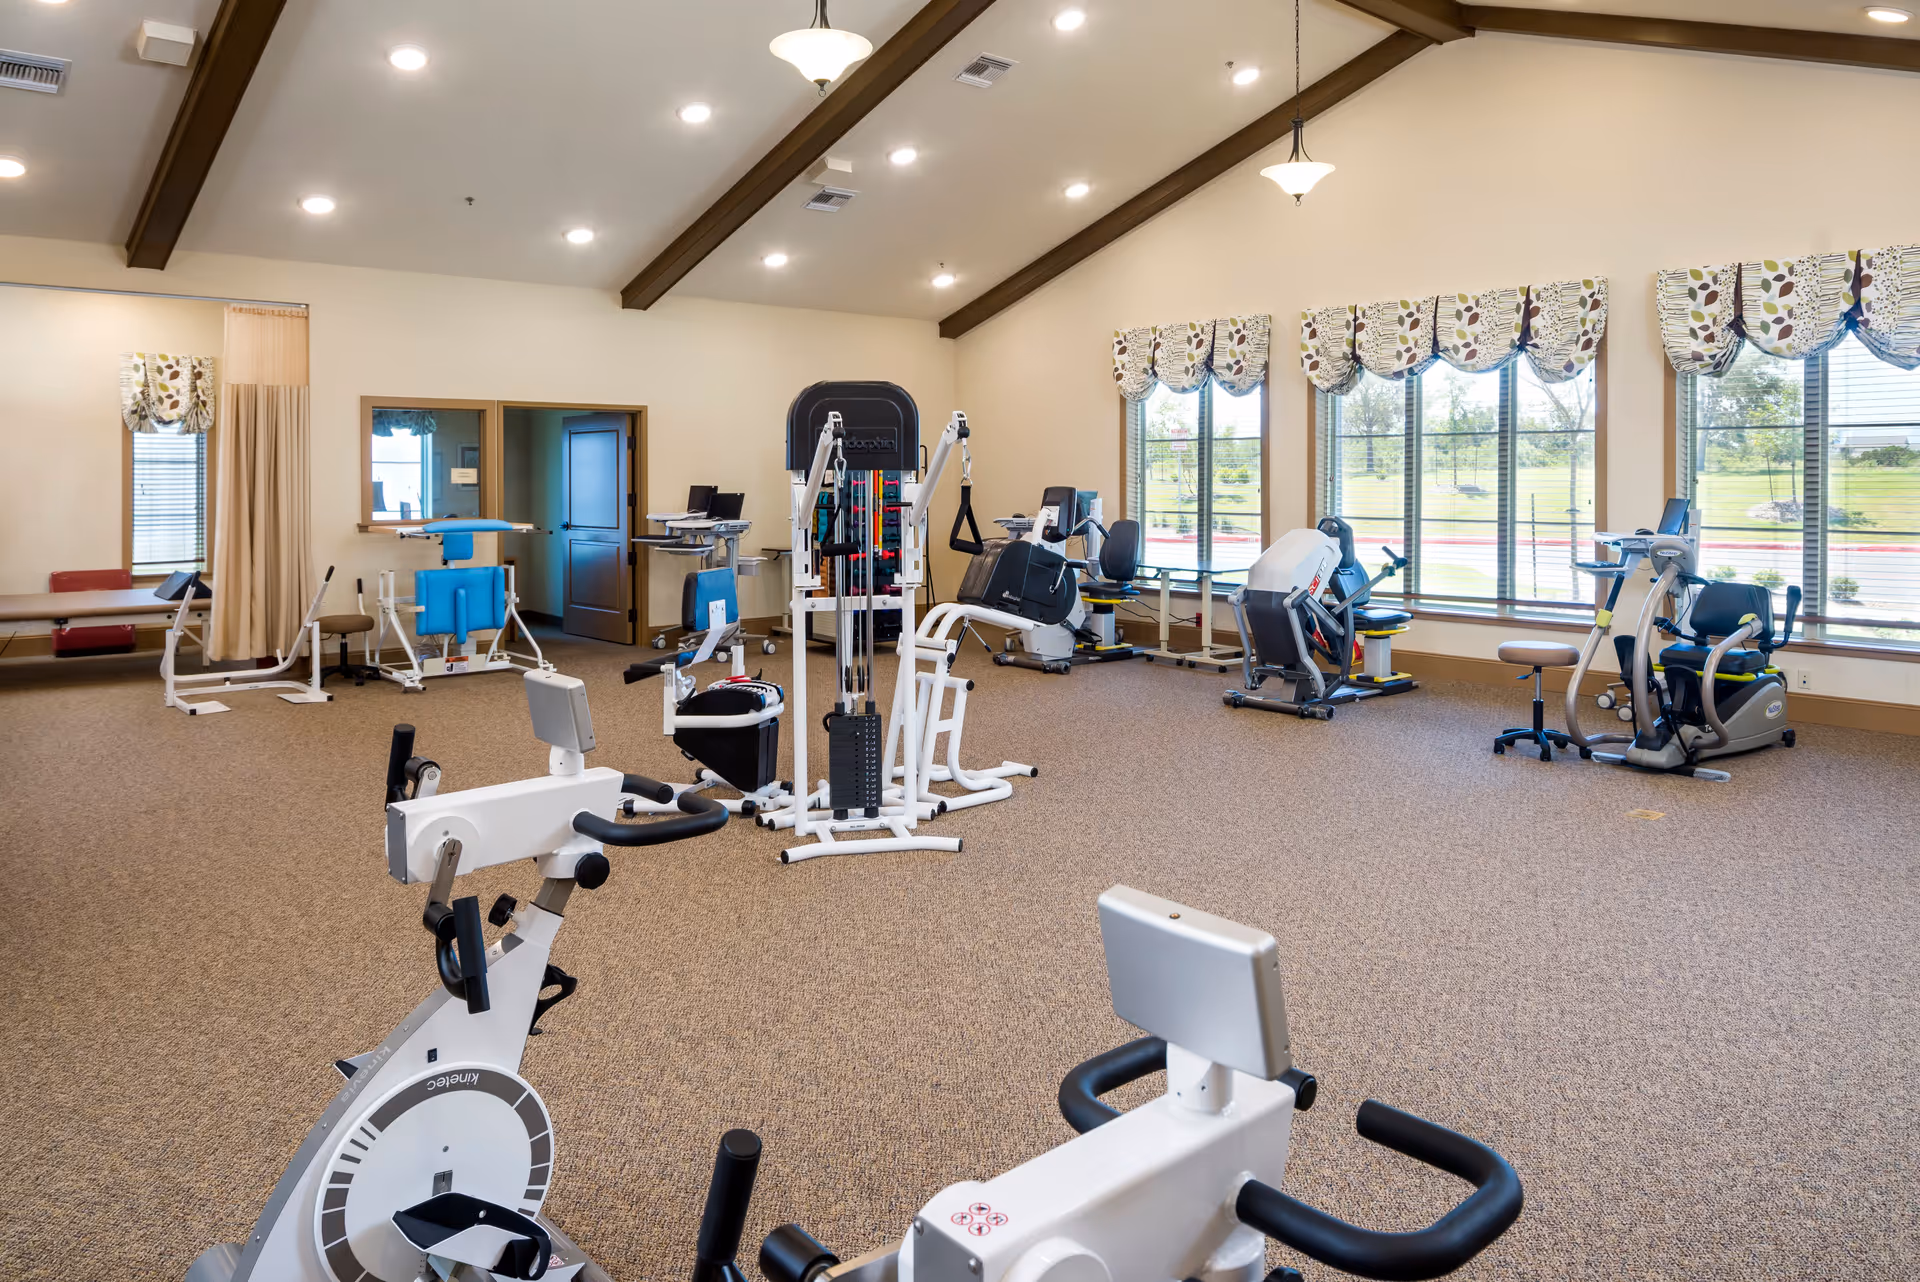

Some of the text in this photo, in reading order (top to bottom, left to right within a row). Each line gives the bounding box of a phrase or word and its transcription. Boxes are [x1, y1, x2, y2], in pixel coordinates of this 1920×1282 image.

[836, 436, 895, 452] ndorphin
[340, 1046, 391, 1103] kinevia
[426, 1072, 479, 1090] kinetec
